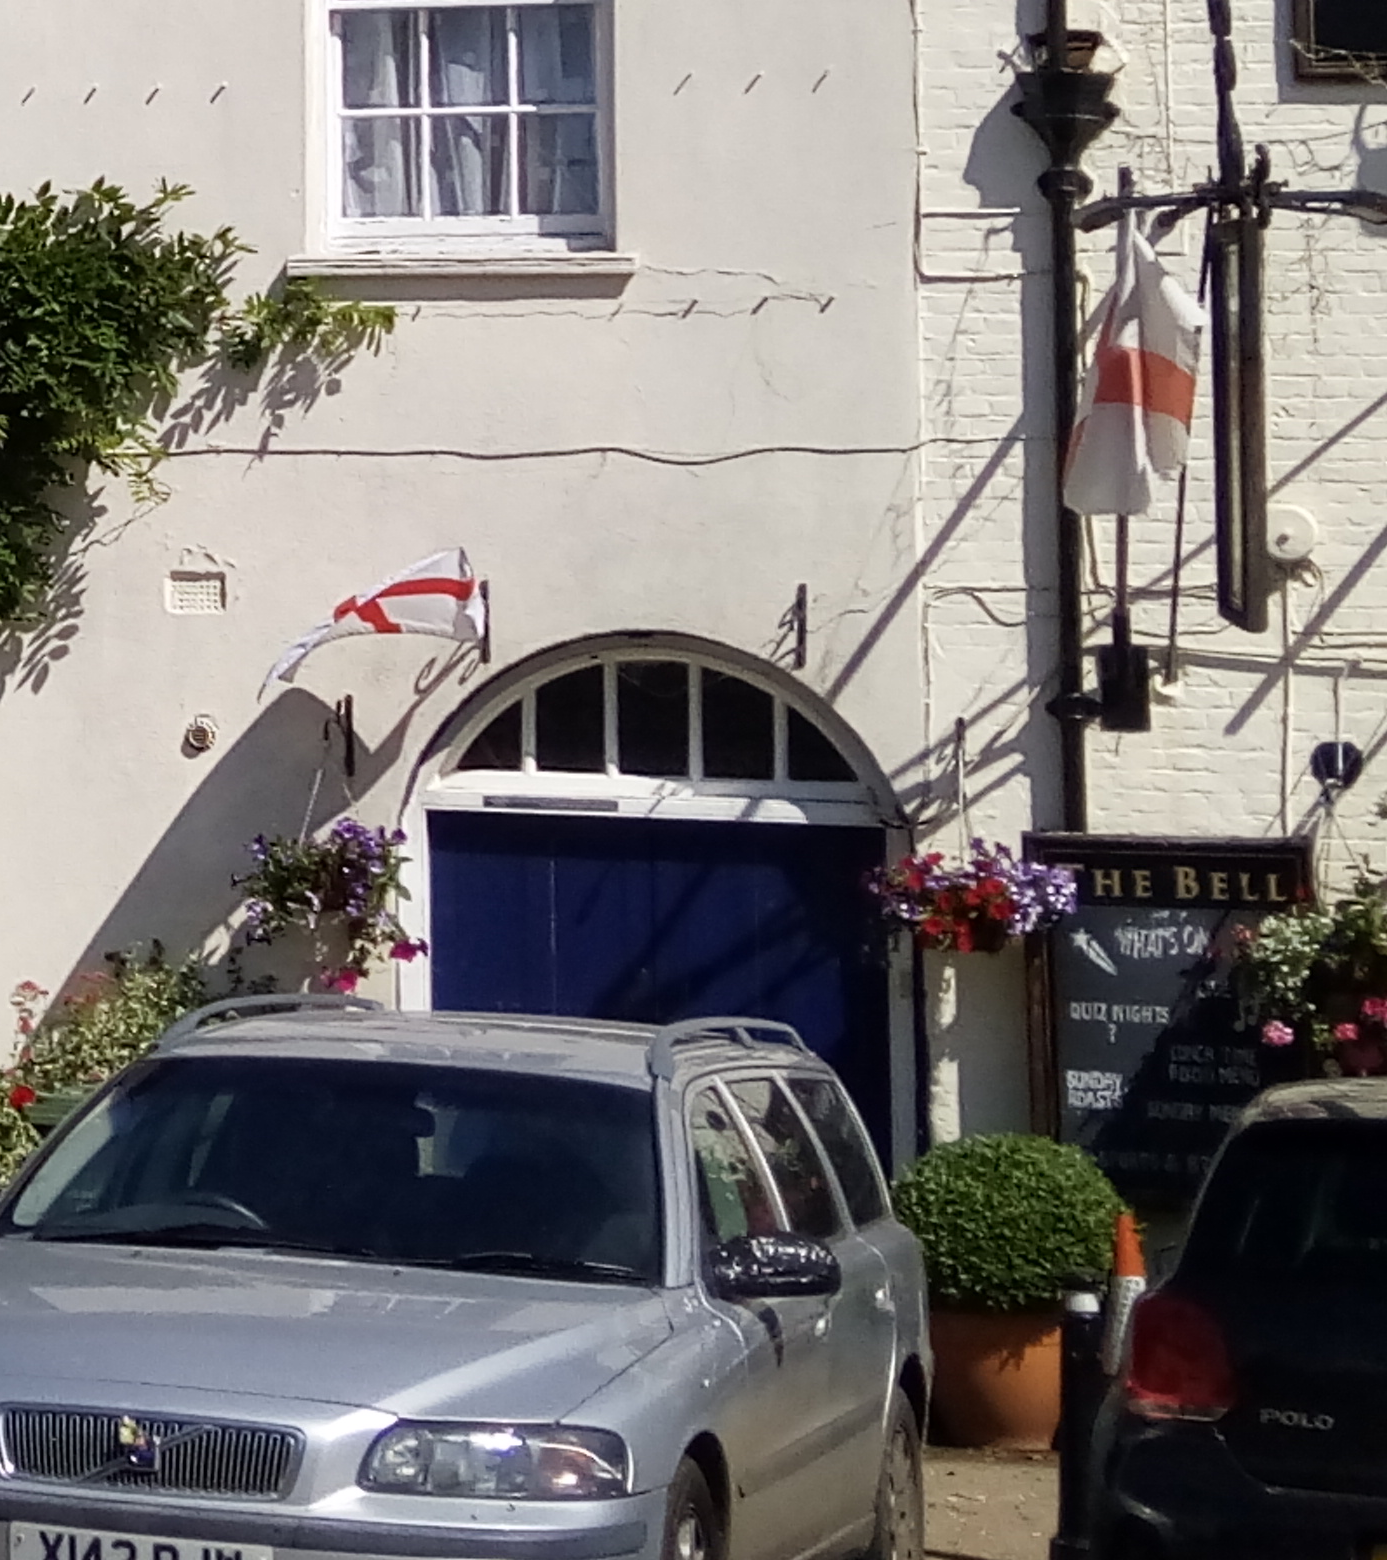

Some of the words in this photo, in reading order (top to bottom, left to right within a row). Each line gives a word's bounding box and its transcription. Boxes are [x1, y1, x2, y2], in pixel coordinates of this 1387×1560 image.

[1173, 865, 1288, 902] BELL
[1114, 926, 1179, 959] WHAT'S
[1069, 1001, 1107, 1022] QUIZ
[1112, 1002, 1170, 1025] NIGHTS
[1065, 1069, 1124, 1091] SUNDAY
[1260, 1408, 1335, 1431] POLO
